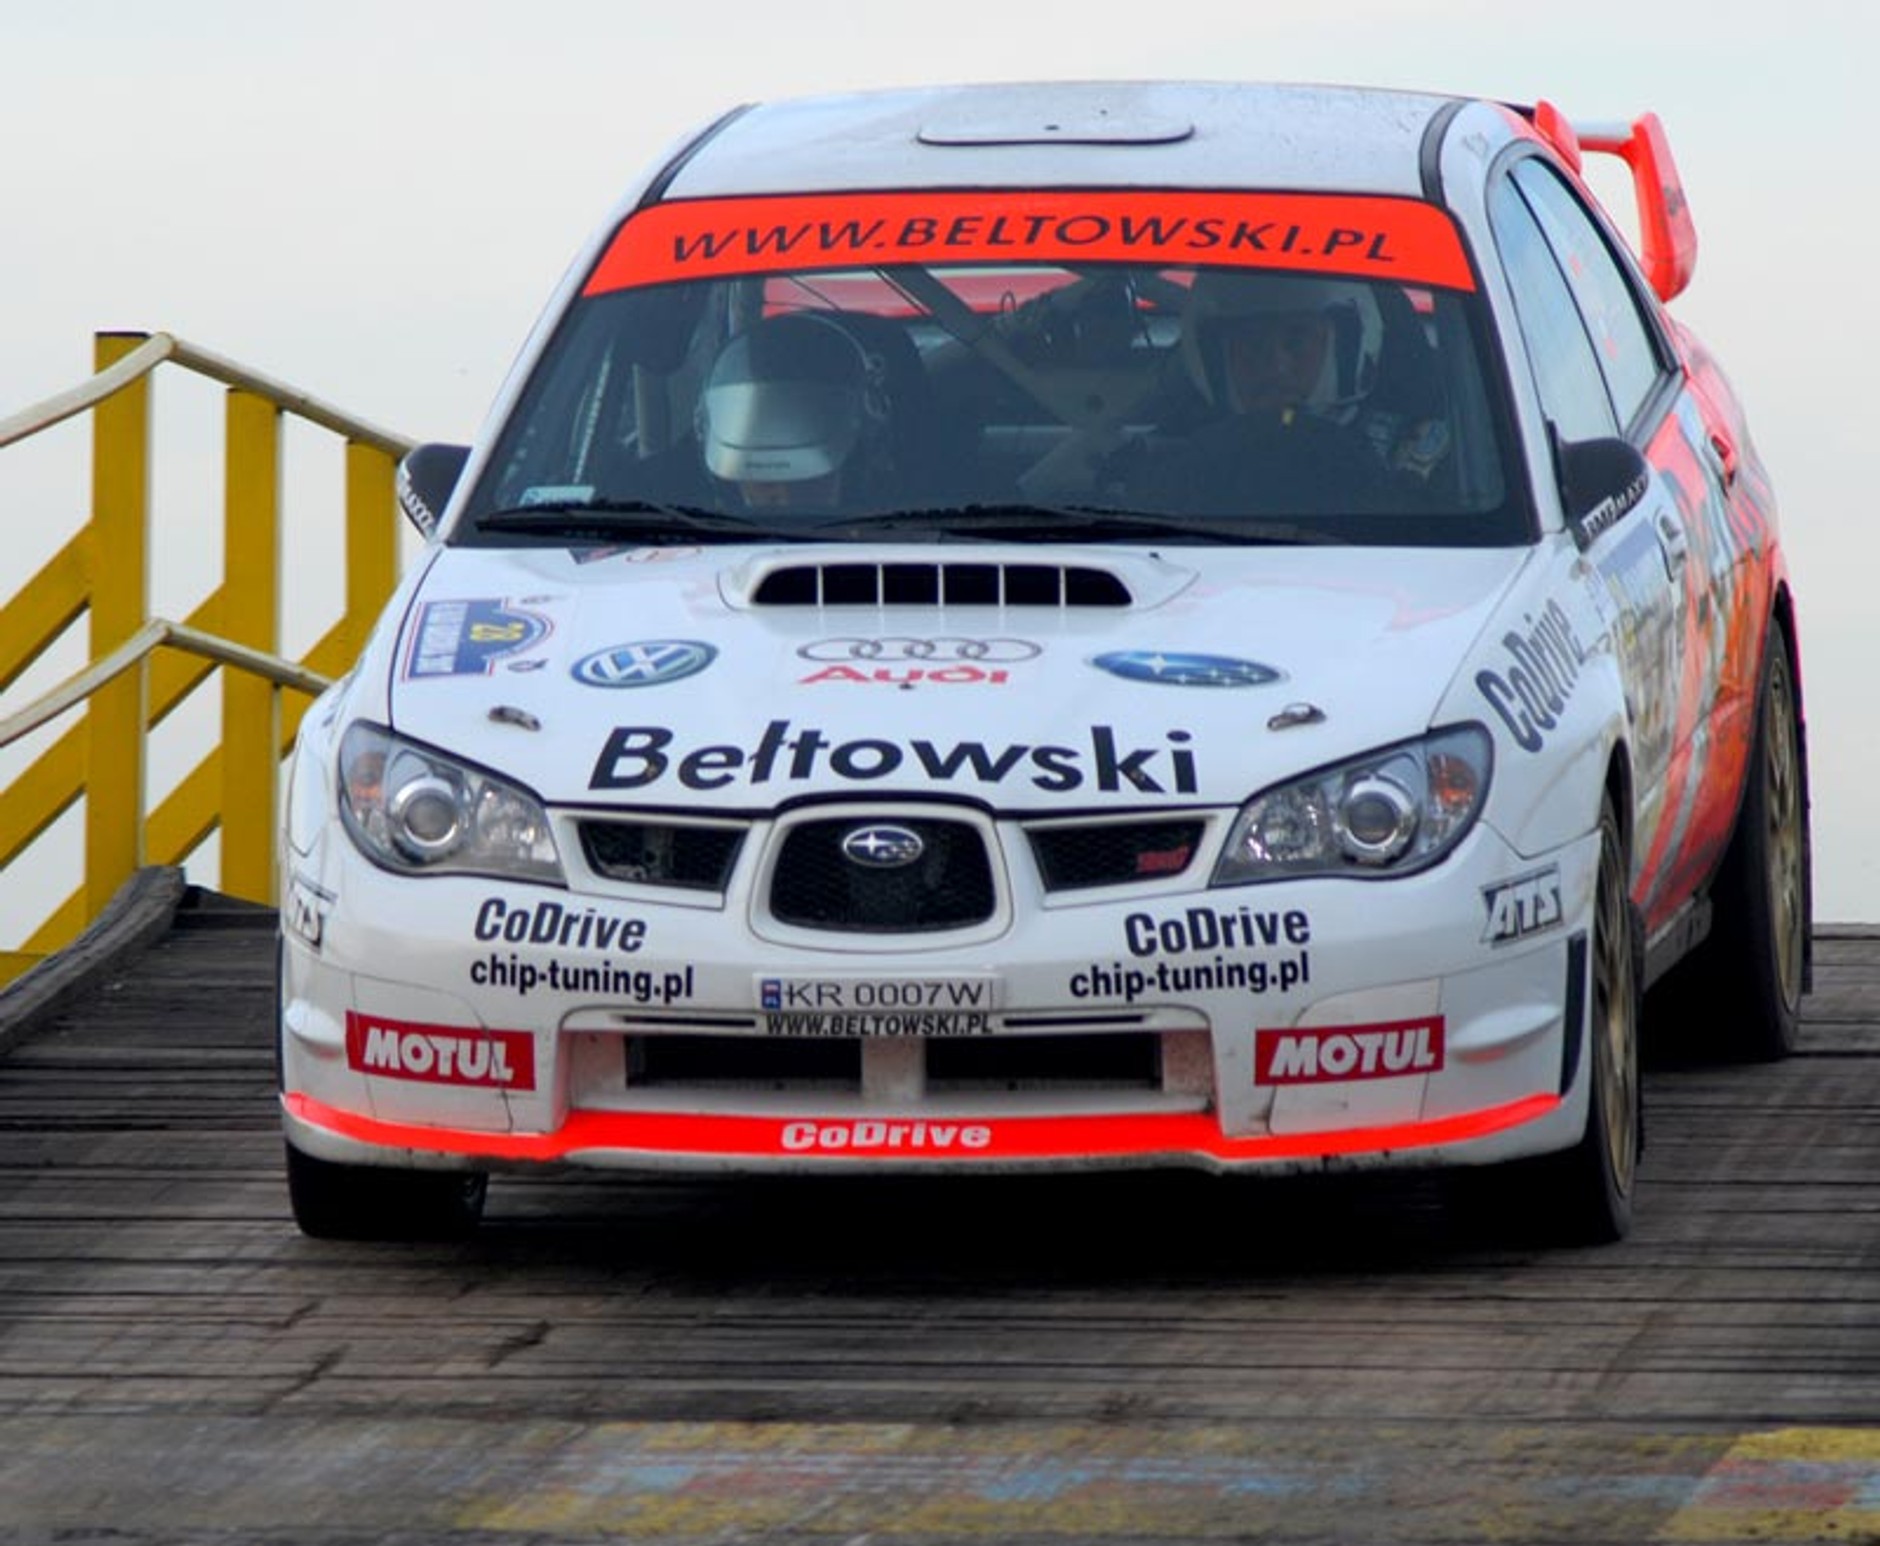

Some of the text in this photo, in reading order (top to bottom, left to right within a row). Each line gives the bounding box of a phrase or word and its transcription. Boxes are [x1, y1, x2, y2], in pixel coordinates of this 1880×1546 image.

[673, 214, 1397, 263] WWW.BELTOWSKI.PL
[798, 665, 1010, 684] Audi
[1475, 597, 1585, 753] CoDrive
[588, 720, 1198, 794] Bełtowski
[474, 898, 647, 952] CoDrive
[1124, 905, 1311, 957] CoDrive
[1481, 872, 1561, 943] ATS
[470, 954, 694, 1003] chip-tuning.pl
[783, 981, 844, 1007] KR
[853, 981, 984, 1007] 0007W
[1070, 951, 1310, 1002] chip-tuning.pl
[766, 1013, 994, 1036] WWW.BELTOWSKI.PL
[363, 1026, 514, 1081] MOTUL
[1269, 1027, 1436, 1078] MOTUL
[780, 1121, 992, 1150] CoDrive
